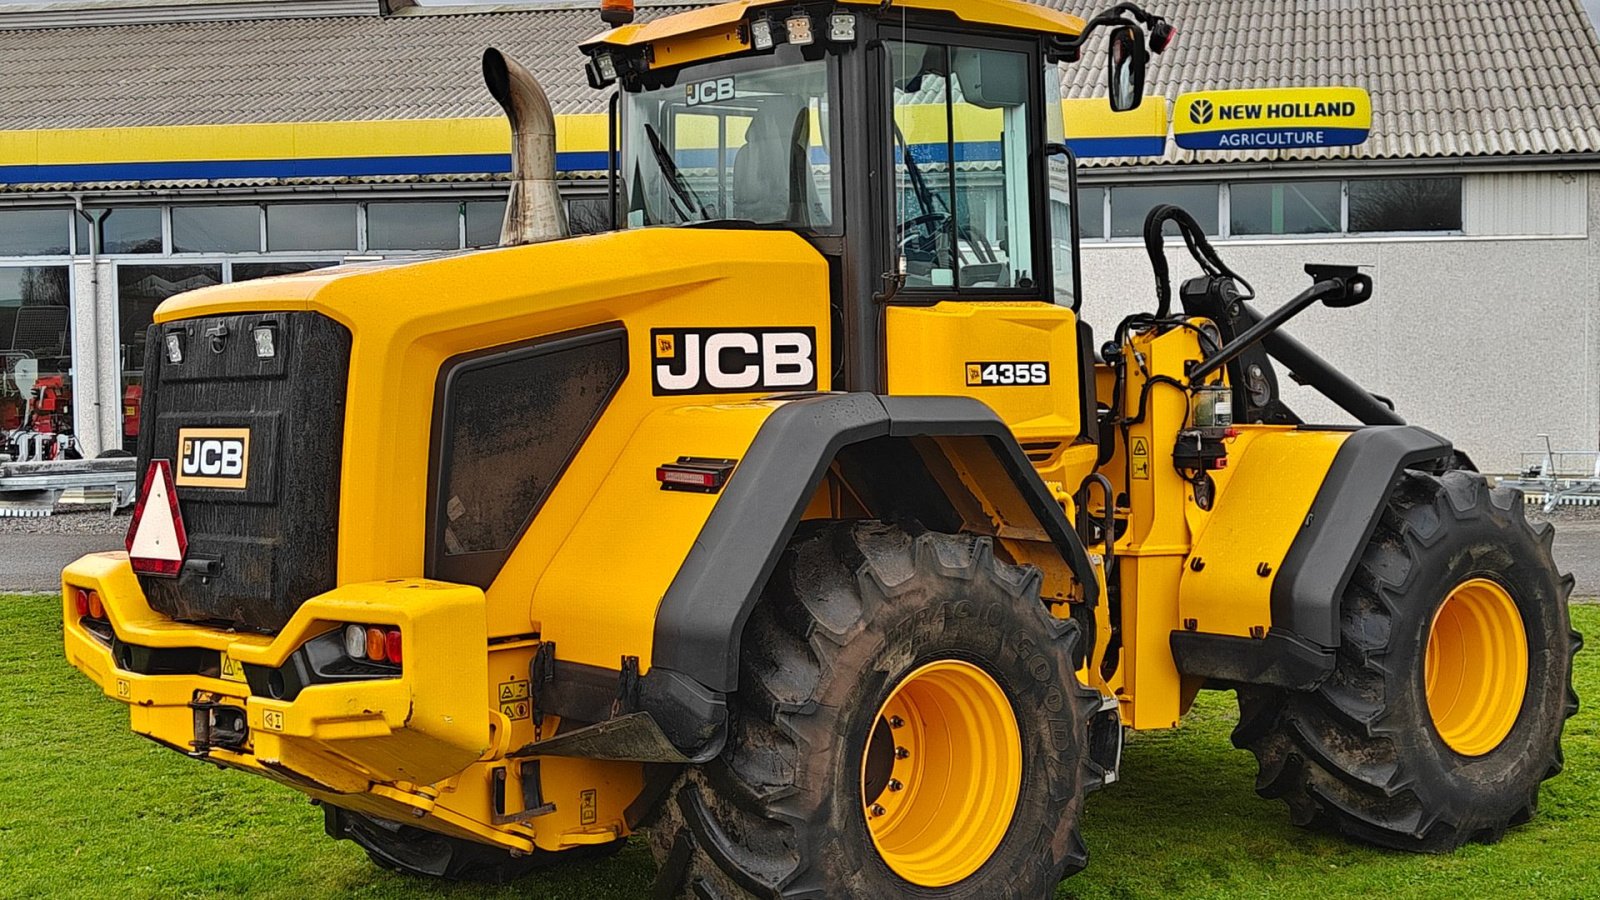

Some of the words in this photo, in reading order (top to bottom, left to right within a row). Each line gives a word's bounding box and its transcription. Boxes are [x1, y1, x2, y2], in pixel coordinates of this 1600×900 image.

[687, 77, 735, 106] JCB
[1219, 104, 1262, 120] NEW
[1267, 102, 1355, 119] HOLLAND
[1218, 131, 1324, 146] AGRICULTURE
[655, 332, 814, 390] JCB
[982, 363, 1047, 384] 435S
[183, 439, 243, 475] JCB
